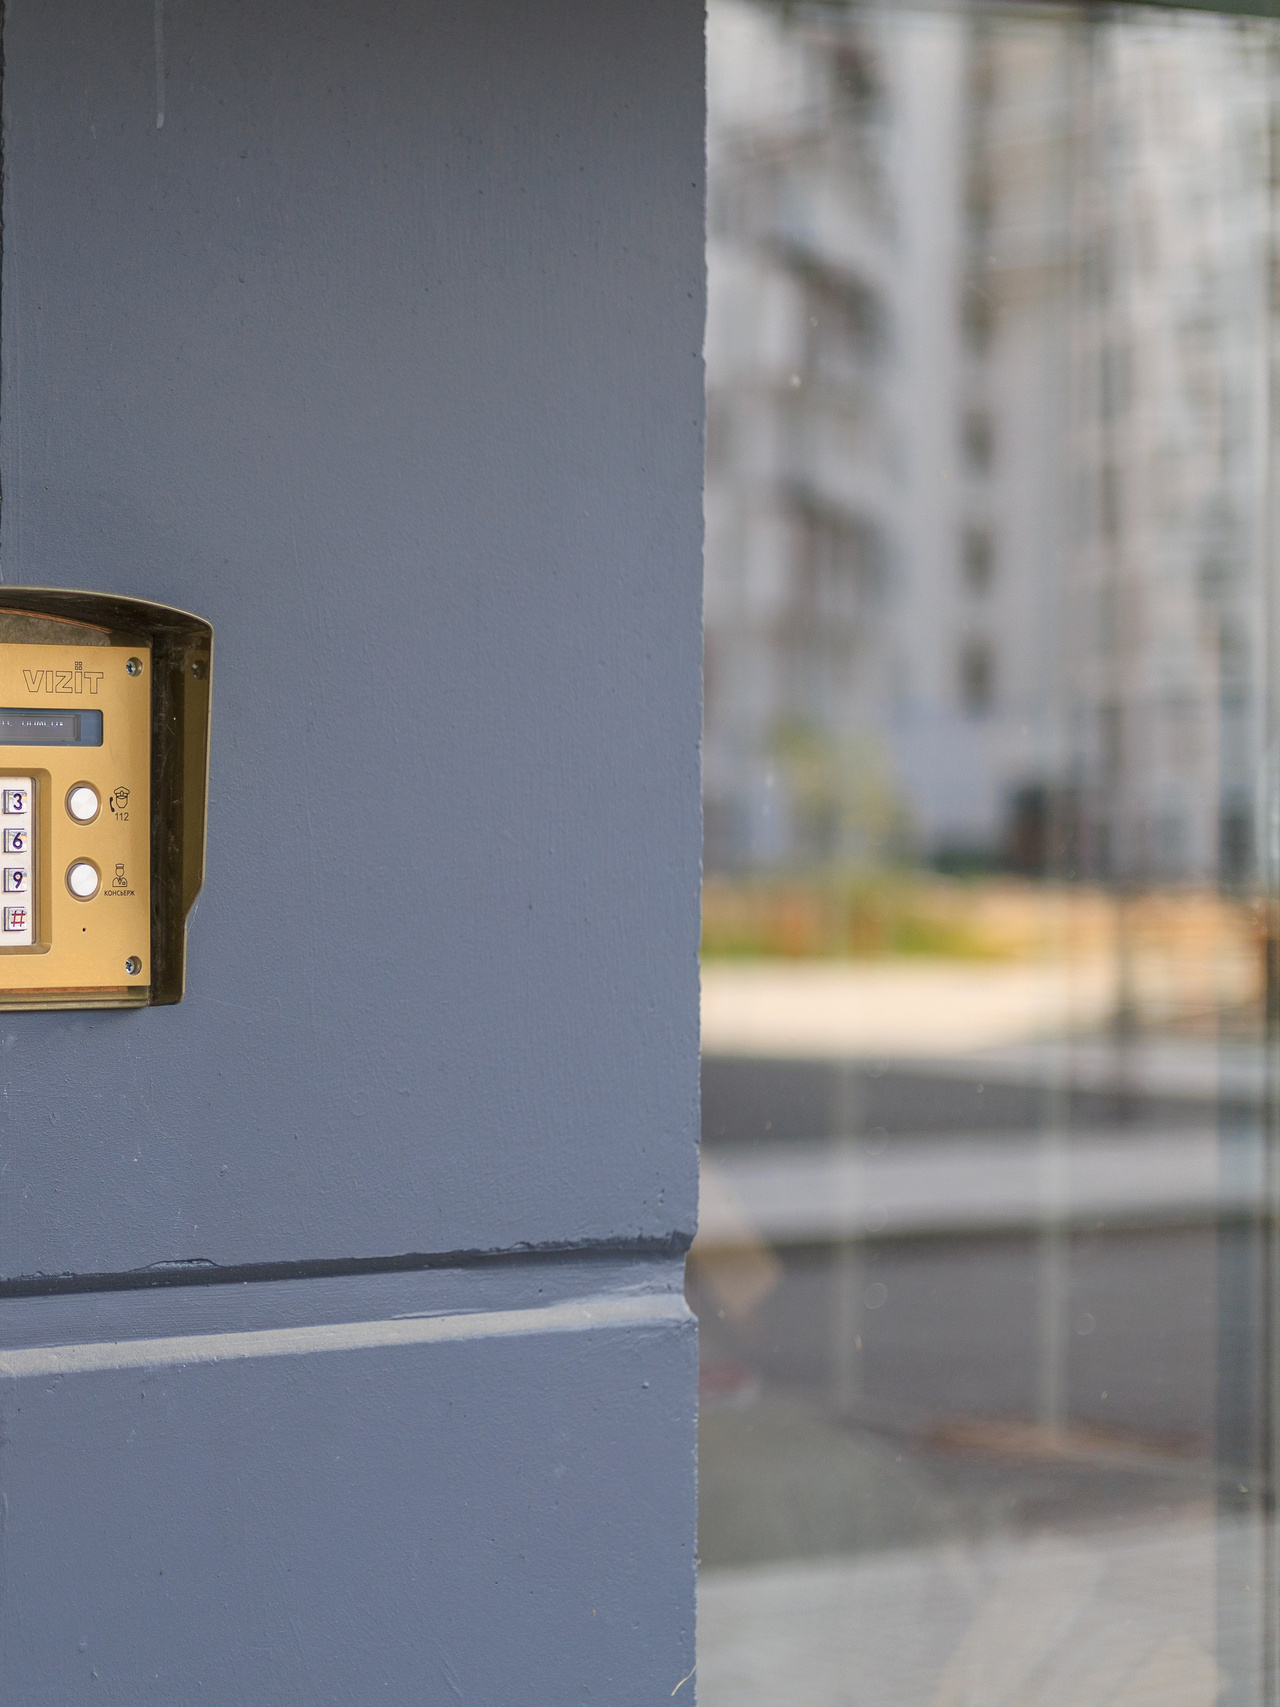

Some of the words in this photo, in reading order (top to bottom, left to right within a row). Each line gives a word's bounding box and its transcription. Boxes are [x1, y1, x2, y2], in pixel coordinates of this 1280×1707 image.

[13, 792, 23, 811] 3
[114, 811, 130, 821] 112
[12, 831, 23, 850] 6
[12, 871, 23, 889] 9
[10, 910, 26, 928] #
